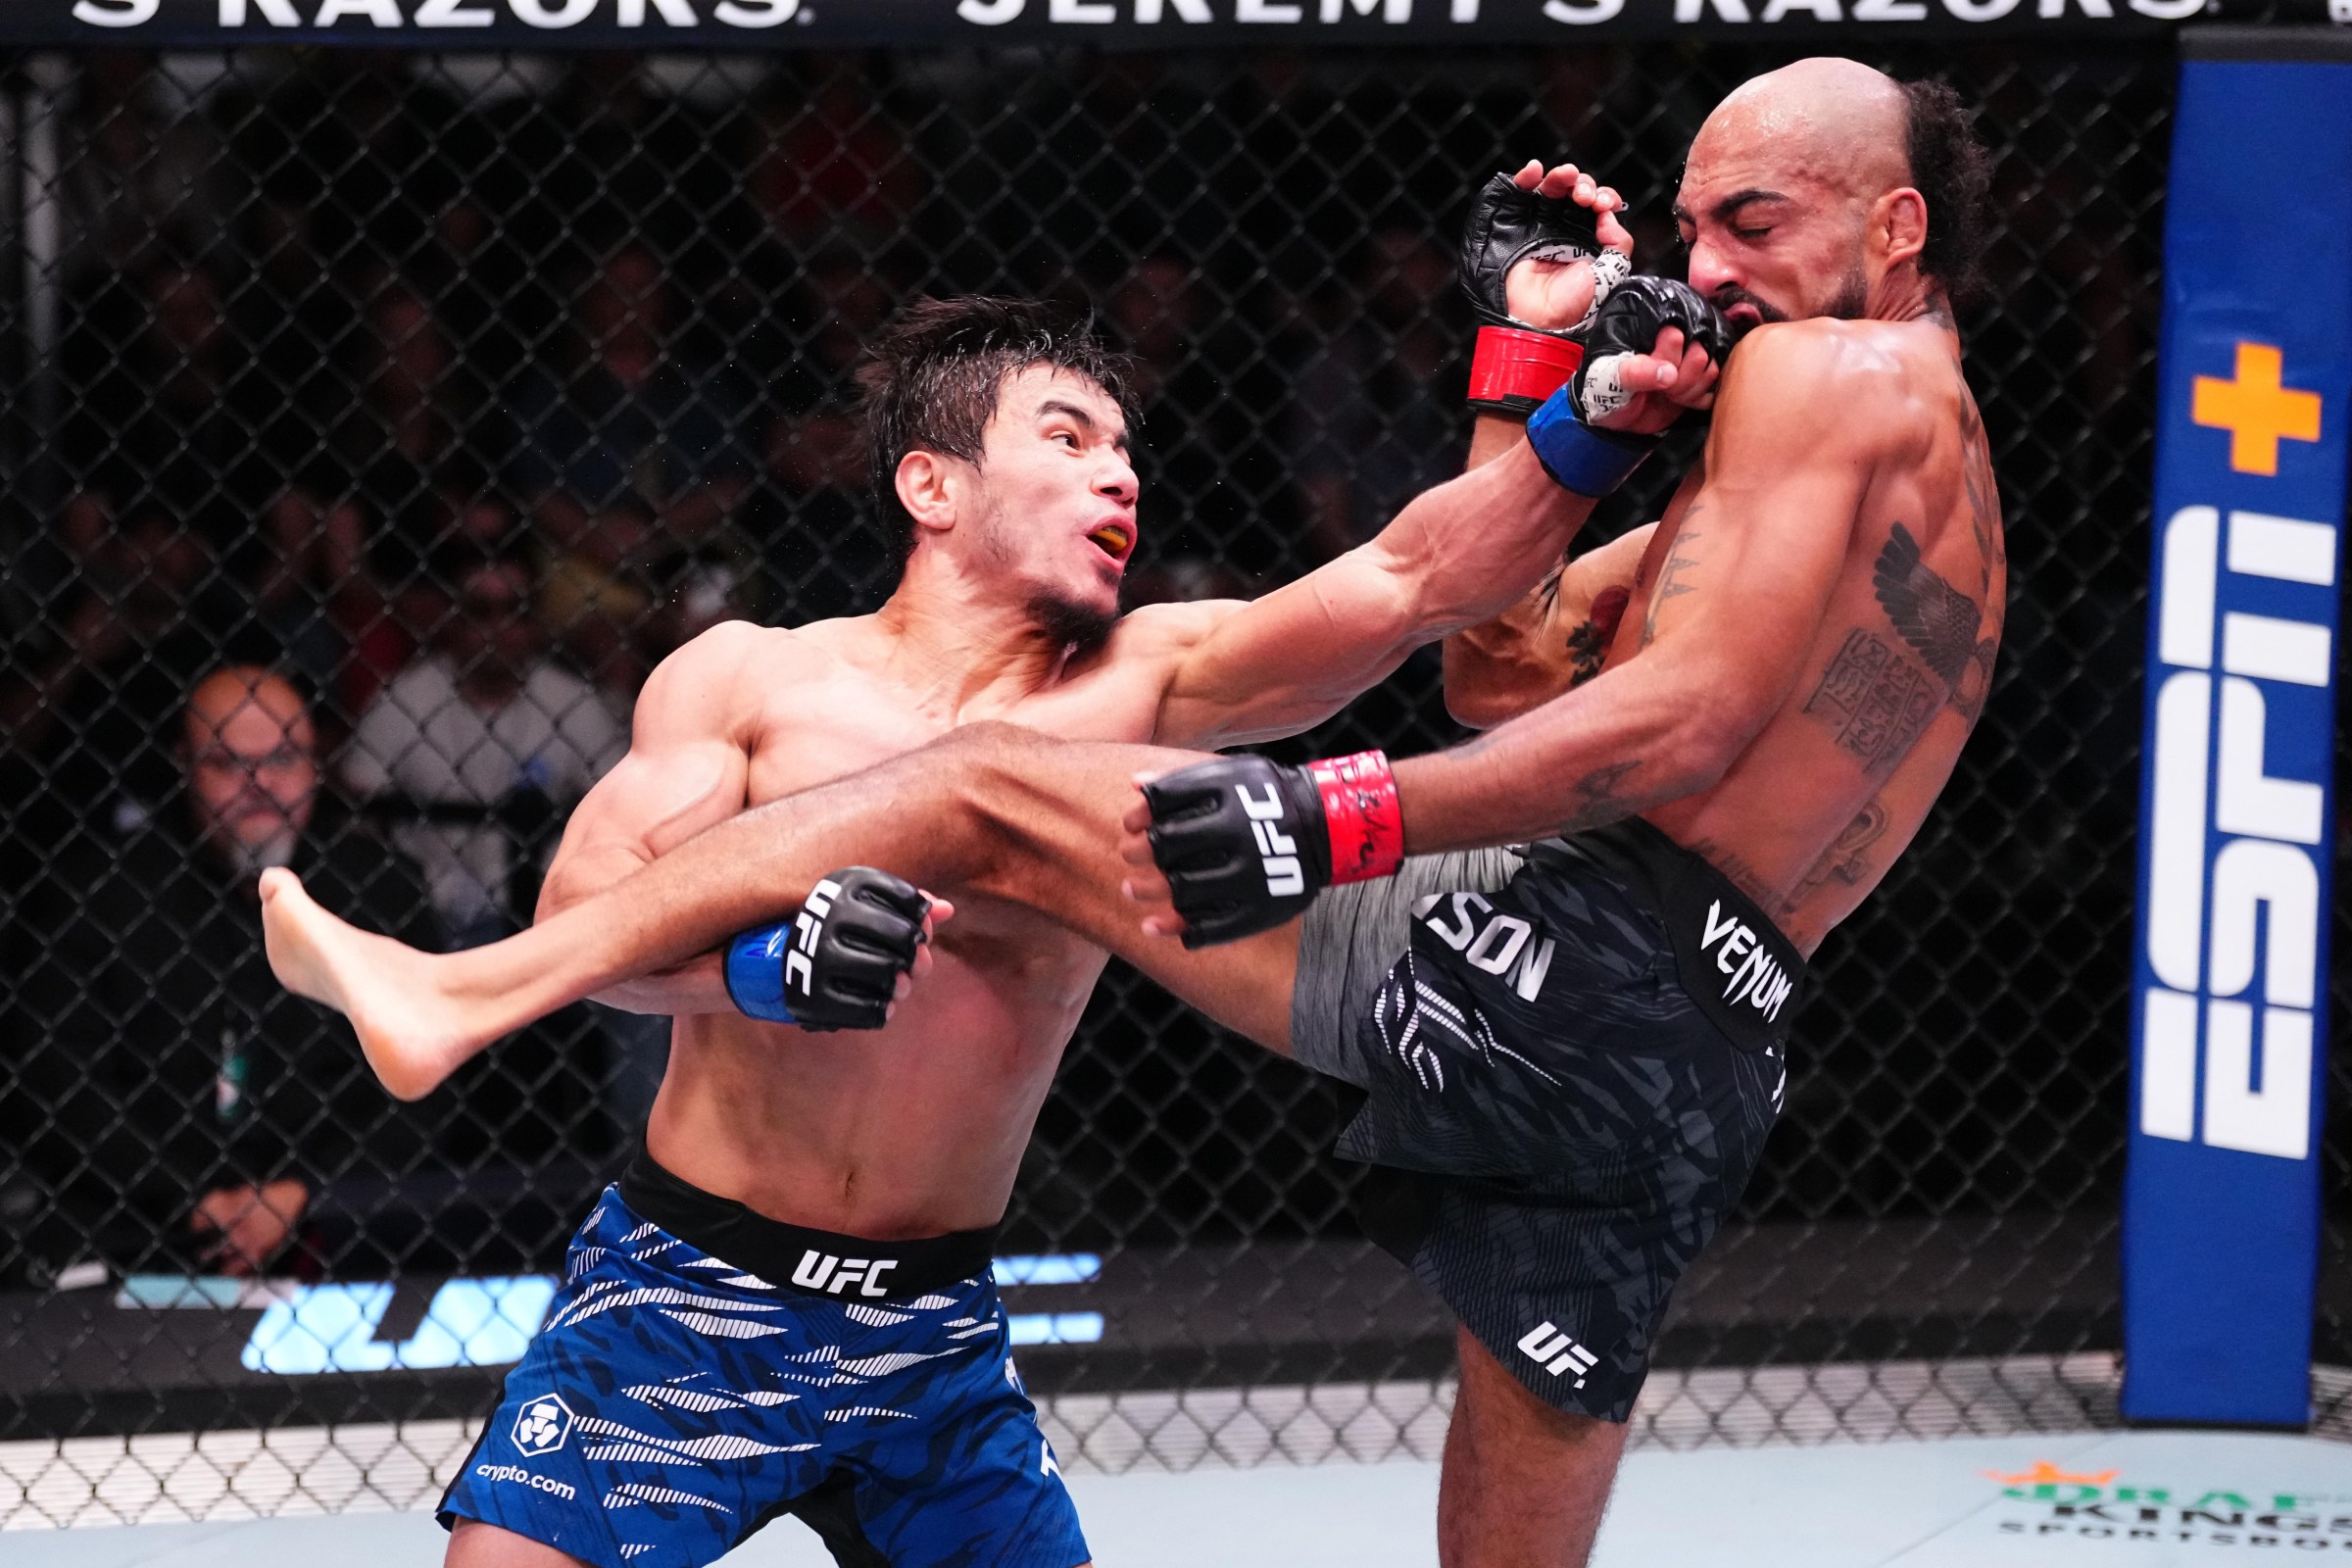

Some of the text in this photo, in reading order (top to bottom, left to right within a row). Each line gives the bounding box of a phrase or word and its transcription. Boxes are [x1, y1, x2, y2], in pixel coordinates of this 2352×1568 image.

[1235, 782, 1305, 898] UFC
[785, 878, 843, 998] UFC
[1411, 892, 1556, 1003] SON
[1700, 898, 1793, 1023] VENUM
[791, 1250, 899, 1297] UFC
[1517, 1320, 1599, 1390] UF
[476, 1464, 576, 1500] crypto.com
[2002, 1482, 2352, 1511] DRAF
[1999, 1522, 2352, 1551] SPORTSBO
